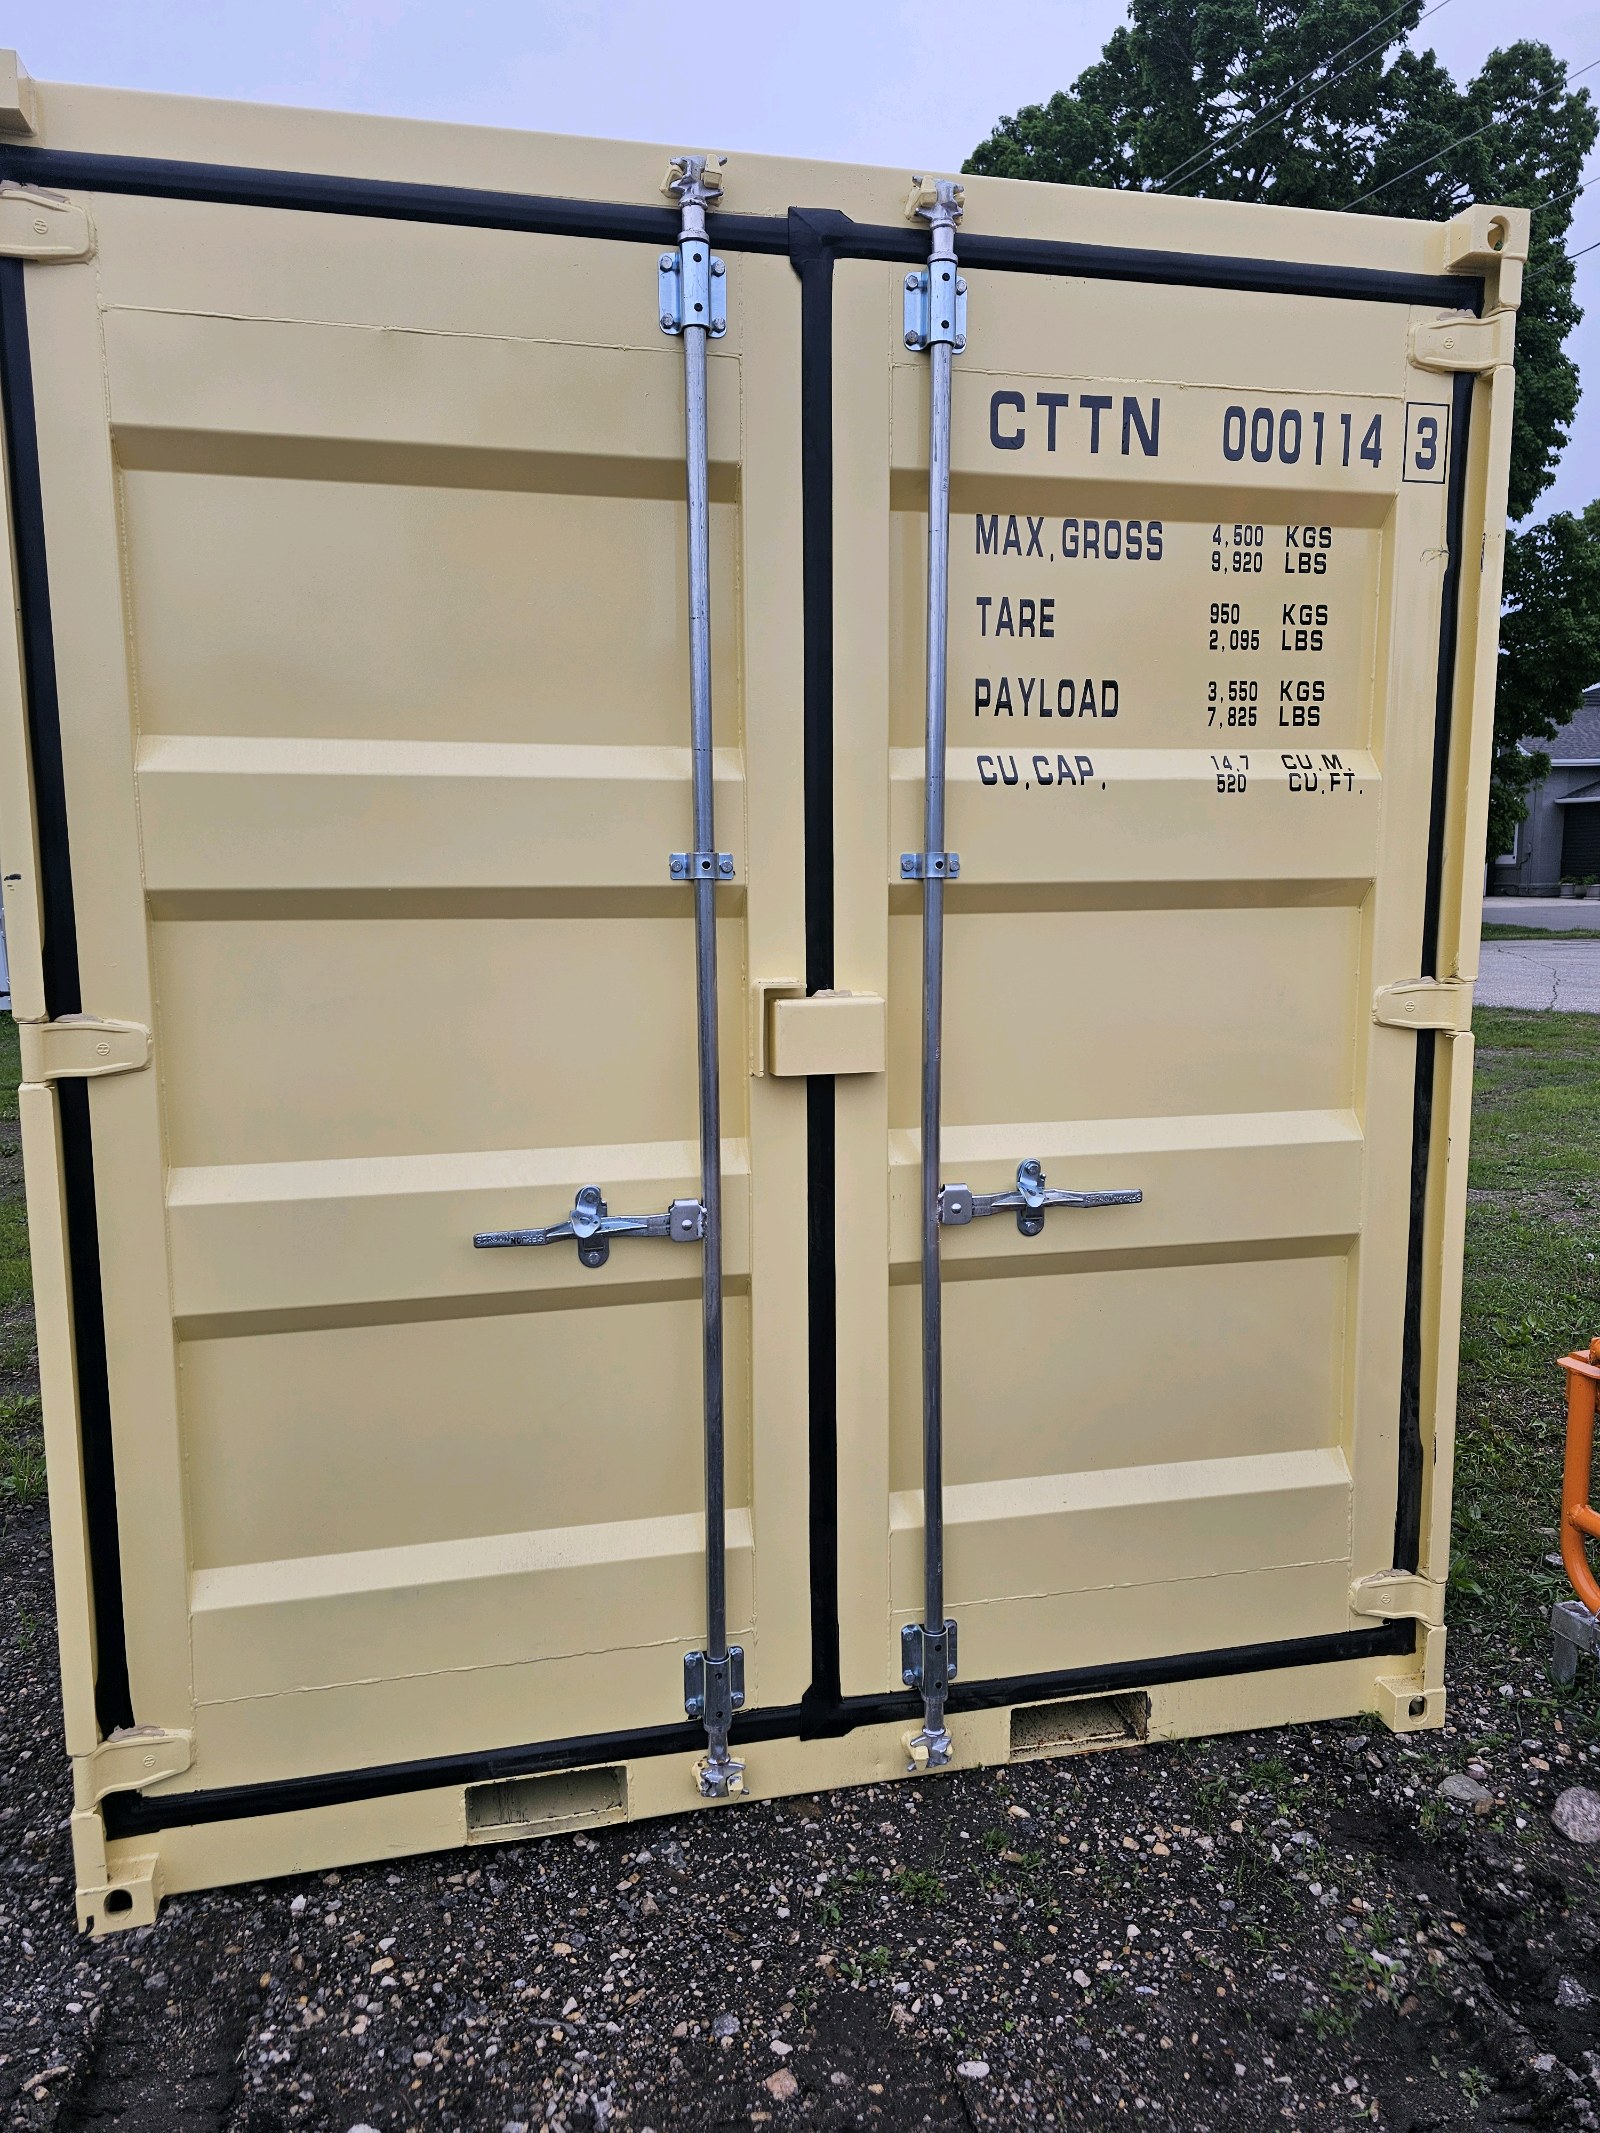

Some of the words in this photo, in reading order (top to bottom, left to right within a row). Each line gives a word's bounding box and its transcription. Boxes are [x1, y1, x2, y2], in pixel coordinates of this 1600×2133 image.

[989, 390, 1161, 457] CTTN
[1222, 405, 1382, 469] 000114
[1415, 416, 1438, 471] 3
[1212, 524, 1264, 548] 4,500
[1285, 525, 1332, 549] KGS
[1211, 550, 1263, 575] 9,920
[1284, 551, 1327, 575] LBS
[976, 596, 1055, 638] TARE
[1210, 602, 1240, 625] 950
[1282, 603, 1328, 626] KGS
[1209, 629, 1260, 653] 2,095
[1281, 629, 1323, 652] LBS
[974, 676, 1119, 718] PAYLOAD
[1207, 680, 1258, 704] 3,550
[1279, 680, 1325, 702] KGS
[1207, 705, 1258, 730] 7,825
[1278, 705, 1321, 727] LBS
[1210, 755, 1249, 772] 14.7
[1216, 773, 1247, 794] 520
